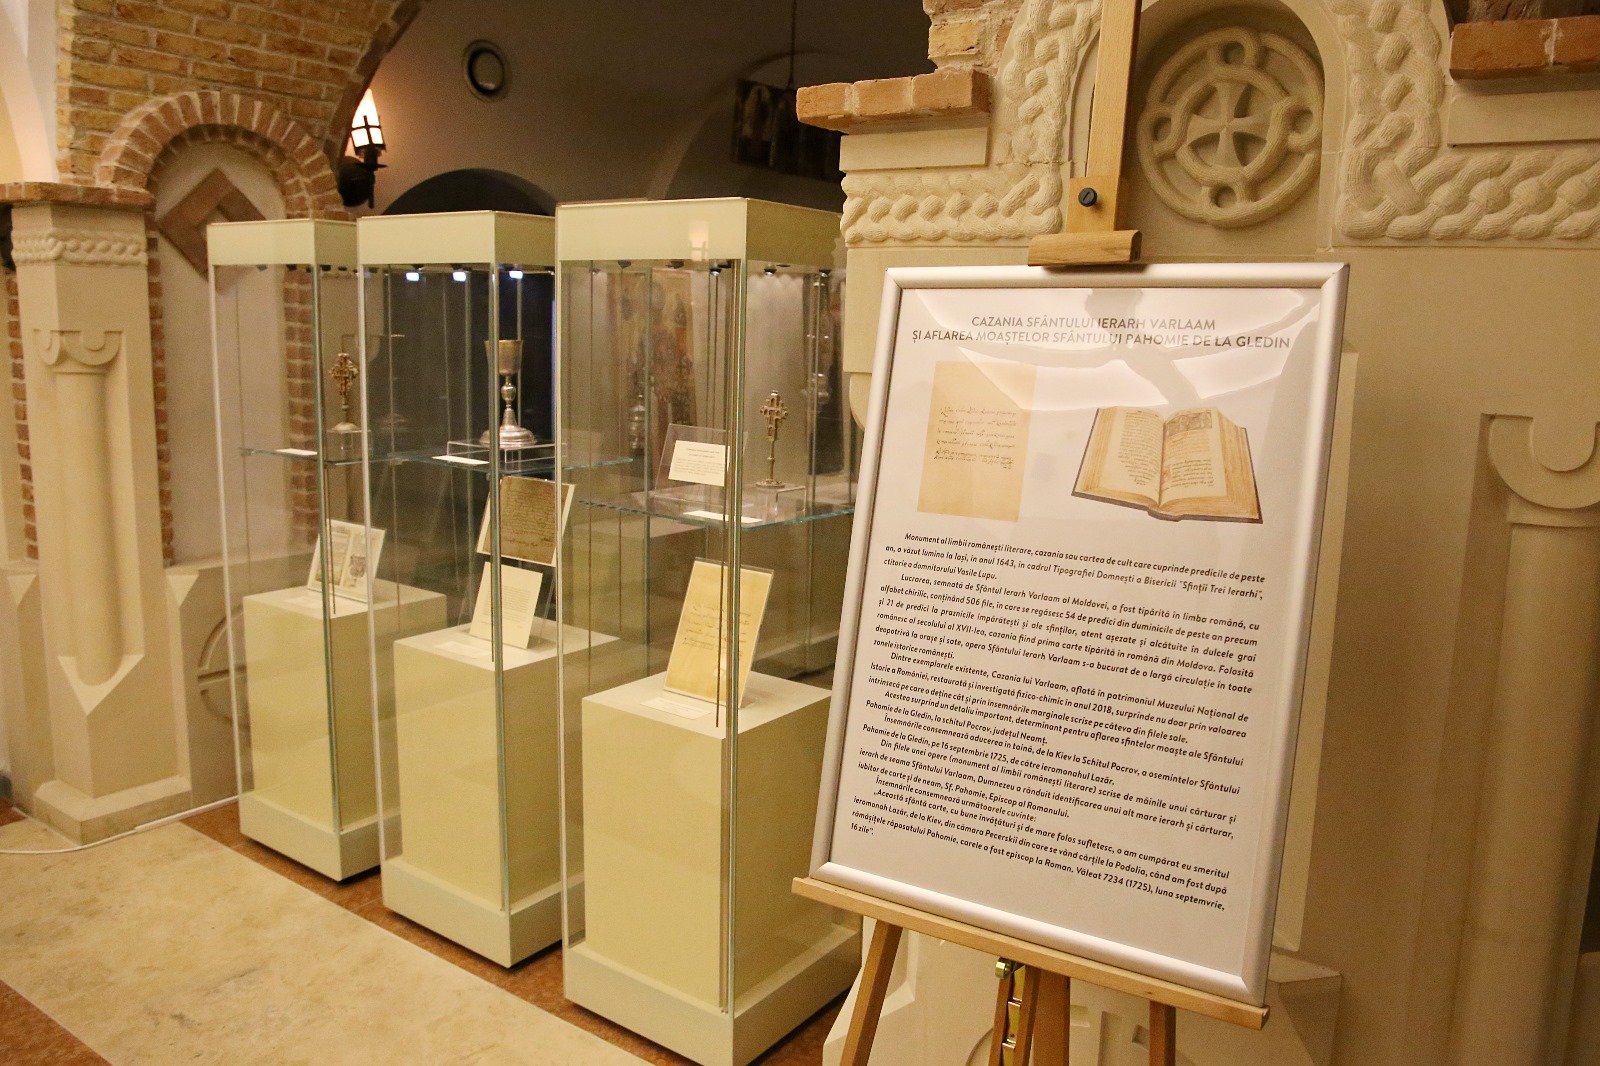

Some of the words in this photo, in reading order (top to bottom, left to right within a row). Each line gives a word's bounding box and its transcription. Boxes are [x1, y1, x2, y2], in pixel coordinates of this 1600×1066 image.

[912, 330, 922, 342] ȘI
[924, 330, 974, 341] AFLAREA
[975, 331, 1050, 346] MOAȘTELOR
[1053, 331, 1122, 345] SFÂNTULUI
[1125, 335, 1189, 346] PAHOMIE
[1193, 336, 1212, 347] DE
[1214, 336, 1232, 348] LA
[1236, 337, 1290, 349] GLEDIN
[971, 317, 1023, 327] CAZANIA
[1026, 315, 1096, 329] SFÂNTULUI
[1097, 319, 1146, 330] IERARH
[1149, 319, 1216, 331] VARLAAM
[905, 533, 940, 544] Monument
[948, 538, 968, 547] limbii
[1004, 545, 1033, 556] literare,
[1035, 550, 1064, 558] cazania
[1079, 556, 1105, 564] cartea
[1106, 557, 1116, 565] de
[1117, 559, 1133, 567] cult
[1153, 564, 1189, 573] cuprinde
[1190, 569, 1228, 578] predicile
[1229, 572, 1240, 580] de
[1241, 575, 1265, 583] peste
[922, 549, 945, 558] lumina
[997, 558, 1016, 568] 1643,
[1027, 563, 1052, 572] cadrul
[1054, 565, 1095, 578] Tipografiei
[1144, 577, 1177, 587] Bisericii
[1211, 585, 1226, 594] Trei
[901, 574, 932, 586] Lucrarea,
[965, 583, 974, 591] de
[1004, 588, 1026, 598] Ierarh
[1029, 591, 1060, 602] Varlaam
[1072, 598, 1109, 611] Moldovei,
[1120, 604, 1136, 613] fost
[1183, 613, 1207, 623] limba
[891, 652, 912, 663] Dintre
[913, 659, 954, 670] exemplarele
[955, 666, 989, 678] existente,
[992, 671, 1021, 683] Cazania
[1023, 676, 1033, 685] lui
[1035, 678, 1069, 692] Varlaam,
[1107, 693, 1156, 706] patrimoniul
[1157, 700, 1195, 713] Muzeului
[1238, 714, 1249, 722] de
[911, 631, 918, 639] la
[947, 639, 963, 647] sate,
[965, 642, 986, 650] opera
[1023, 650, 1046, 660] Ierarh
[1049, 654, 1080, 666] Varlaam
[1097, 662, 1128, 674] bucurat
[1130, 668, 1140, 676] de
[1229, 684, 1252, 694] toate
[1016, 690, 1064, 706] fizico-chimic
[1092, 704, 1114, 716] 2018,
[1116, 710, 1155, 722] surprinde
[1168, 718, 1188, 727] doar
[1189, 722, 1206, 731] prin
[1209, 726, 1247, 738] valoarea
[881, 739, 892, 748] Din
[894, 742, 910, 752] filele
[928, 752, 948, 761] opere
[949, 755, 990, 770] (monument
[1001, 766, 1022, 777] limbii
[1064, 780, 1097, 794] literare)
[1098, 790, 1121, 799] scrise
[1124, 793, 1134, 801] de
[1169, 804, 1188, 812] unui
[928, 804, 949, 814] carte,
[960, 809, 978, 820] bune
[1025, 825, 1034, 833] de
[1036, 830, 1055, 839] mare
[1057, 832, 1076, 843] folos
[1078, 839, 1115, 854] sufletesc,
[1194, 867, 1230, 879] smeritul
[927, 829, 959, 844] Pahomie,
[960, 840, 982, 850] carele
[990, 845, 1005, 855] fost
[1006, 851, 1034, 864] episcop
[1036, 857, 1043, 865] la
[1045, 859, 1074, 873] Roman.
[1103, 874, 1124, 885] 7234
[1126, 879, 1153, 894] (1725),
[1155, 886, 1174, 898] luna
[1175, 894, 1224, 911] septemvrie,
